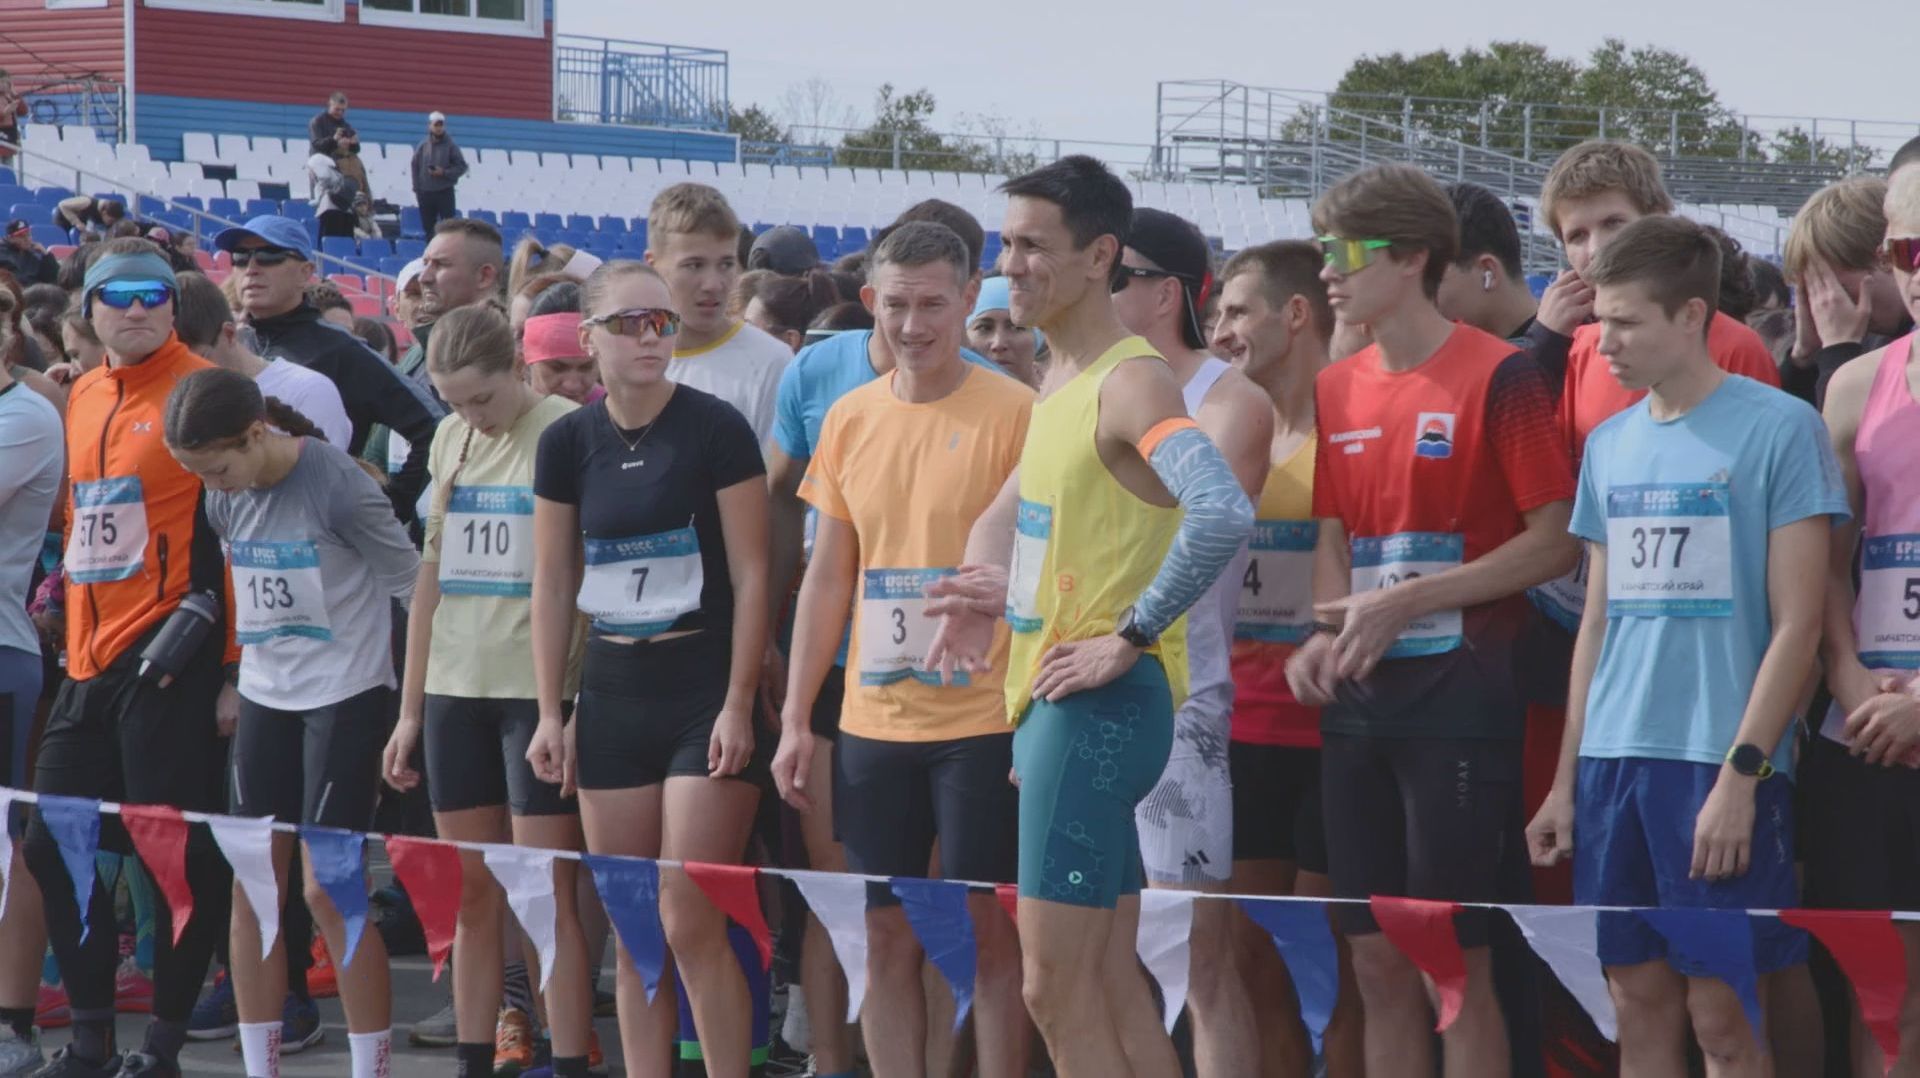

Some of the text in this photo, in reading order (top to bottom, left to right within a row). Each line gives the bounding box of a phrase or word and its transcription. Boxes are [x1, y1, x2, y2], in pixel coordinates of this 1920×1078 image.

[463, 519, 509, 556] 110
[1631, 526, 1690, 569] 377
[248, 575, 294, 610] 153
[631, 566, 649, 602] 7
[1243, 559, 1262, 596] 4
[1903, 577, 1920, 620] 5
[892, 607, 906, 645] 3
